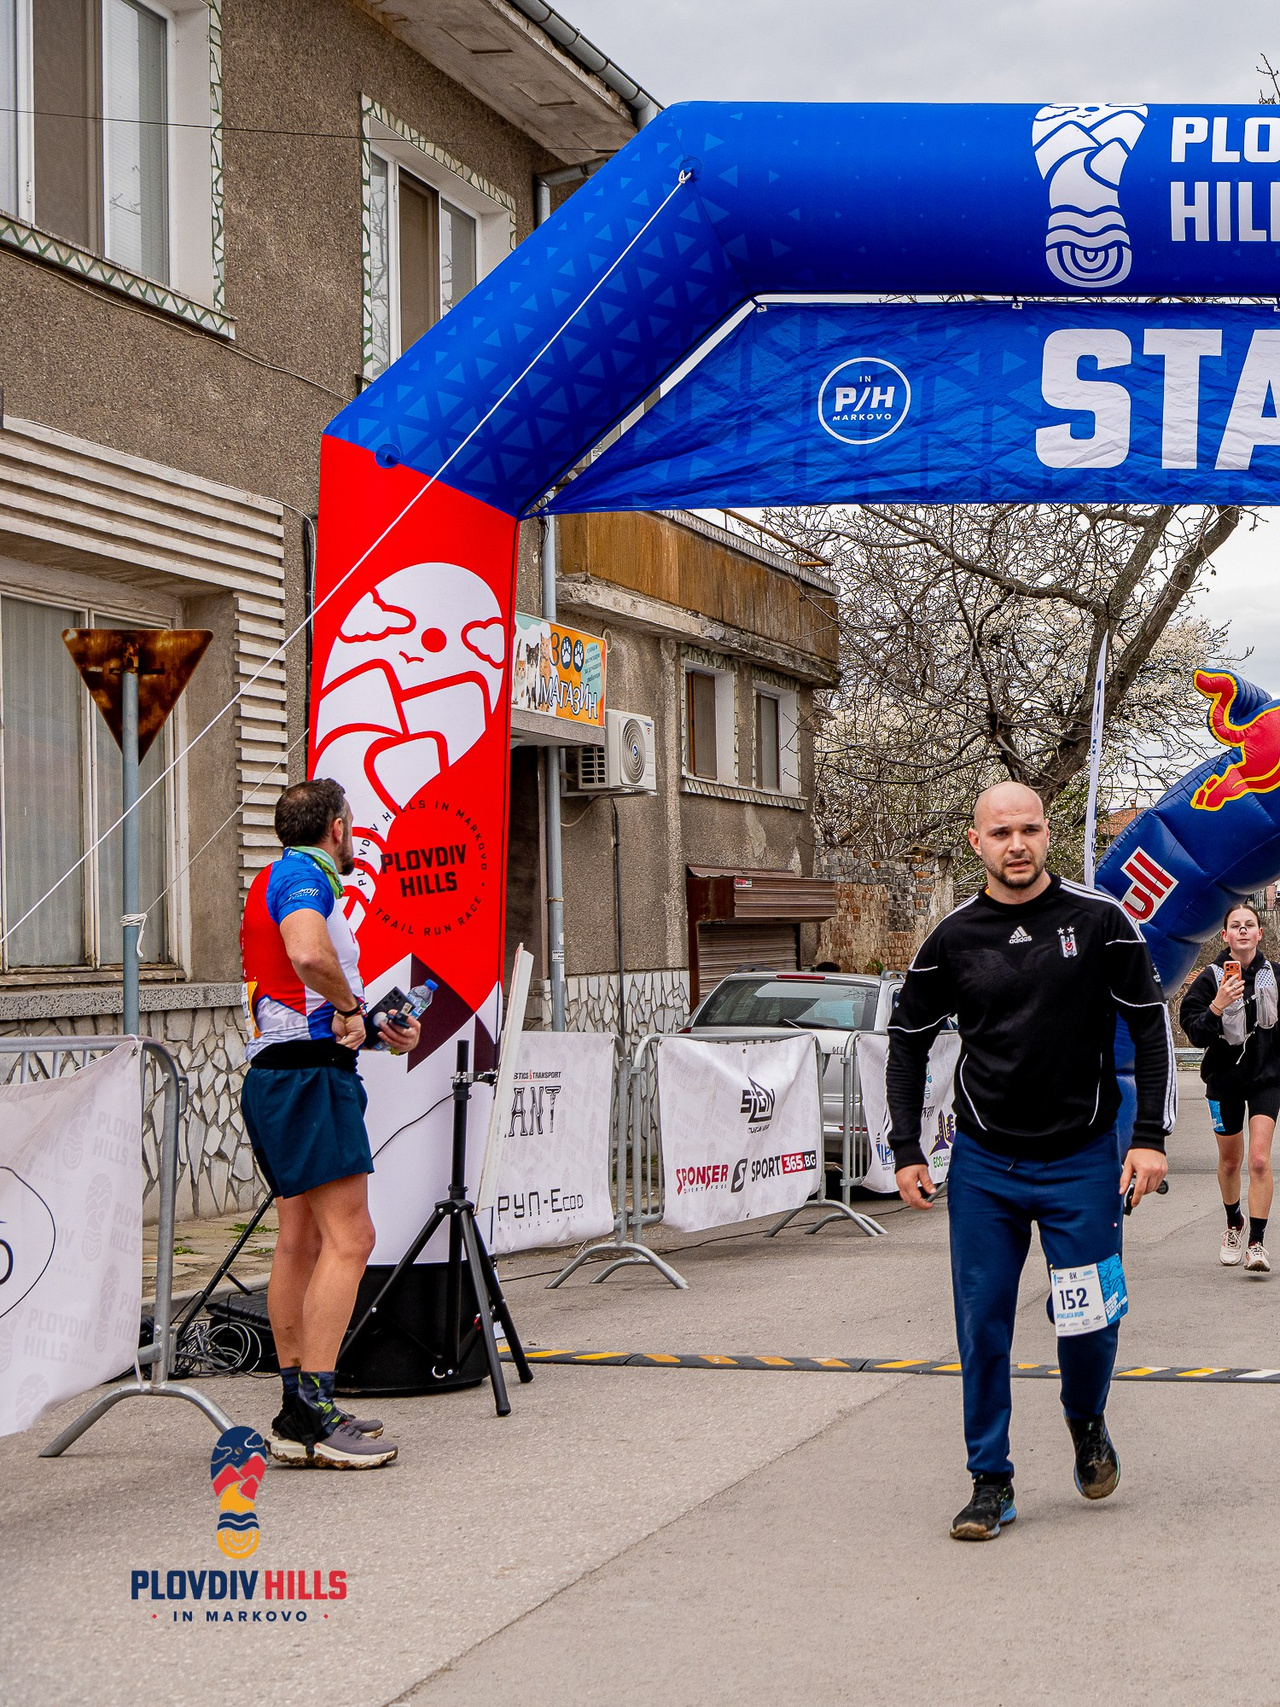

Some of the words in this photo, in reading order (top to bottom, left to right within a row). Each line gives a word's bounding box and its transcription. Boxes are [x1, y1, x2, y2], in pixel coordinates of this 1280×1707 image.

[859, 375, 872, 383] IN
[835, 386, 895, 412] P/H
[832, 413, 892, 421] MARKOVO
[540, 675, 598, 719] МАГАЗИН
[434, 801, 450, 811] IN
[455, 809, 488, 871] MARKOVO
[380, 843, 466, 875] PLOVDIV
[400, 871, 458, 898] HILLS
[374, 907, 414, 935] TRAIL
[423, 923, 452, 936] RUN
[456, 896, 483, 926] RACE
[1008, 935, 1033, 945] adidas
[532, 1071, 562, 1080] TRANSPORT
[675, 1164, 729, 1195] SPONSER
[1059, 1287, 1090, 1311] 152
